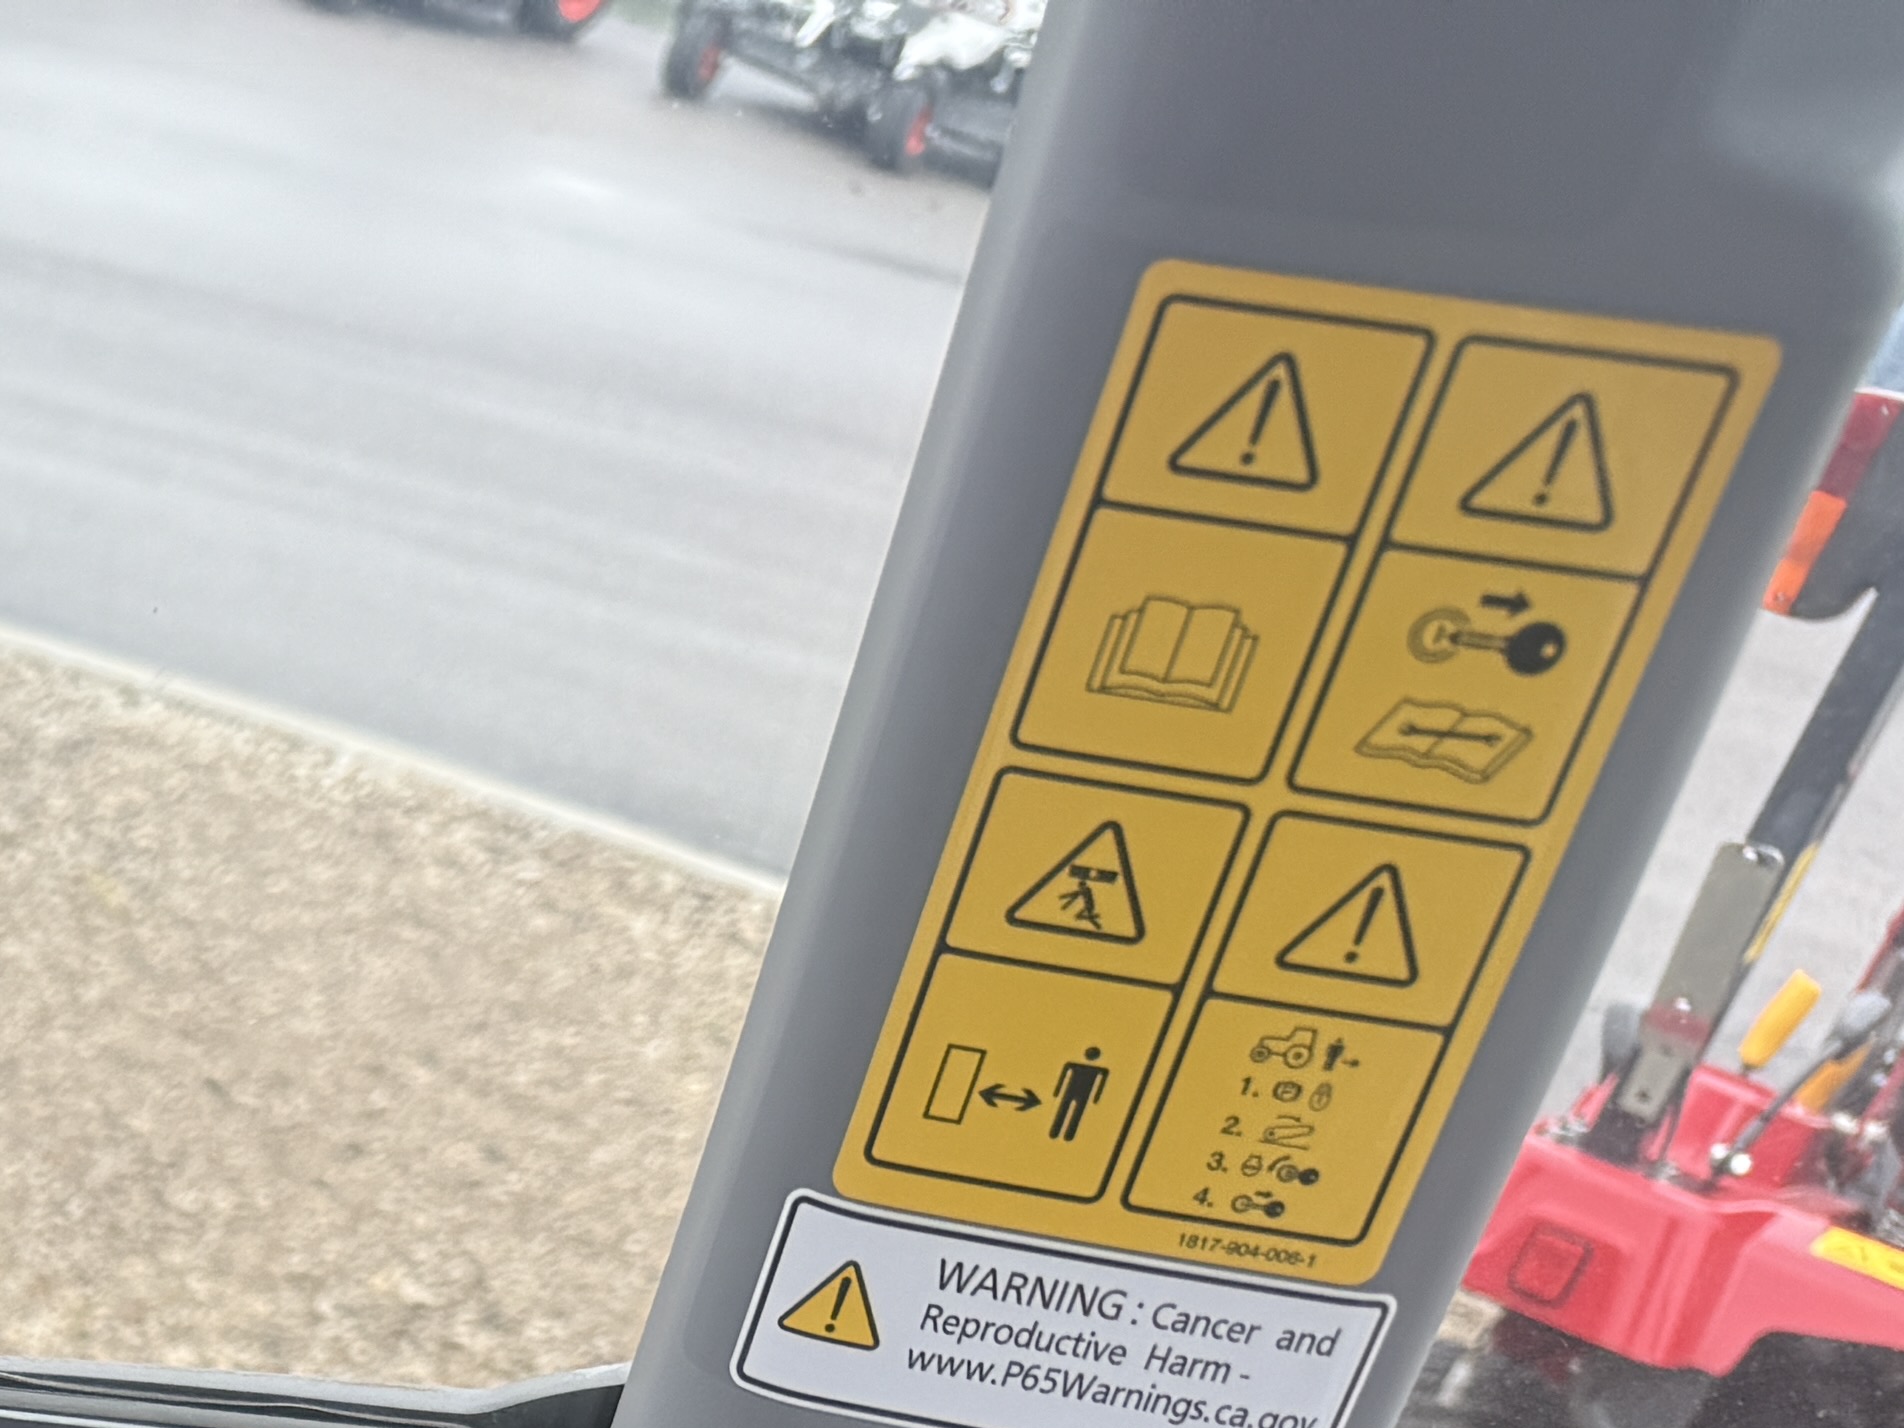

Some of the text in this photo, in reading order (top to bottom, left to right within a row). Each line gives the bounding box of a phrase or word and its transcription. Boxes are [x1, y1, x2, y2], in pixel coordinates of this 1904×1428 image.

[1241, 1076, 1259, 1099] 1.
[1221, 1115, 1242, 1137] 2.
[1206, 1151, 1228, 1173] 3.
[1192, 1187, 1213, 1209] 4.
[1151, 1302, 1262, 1347] Cancer
[1274, 1321, 1343, 1359] and
[919, 1302, 1128, 1368] Reproductive
[1143, 1343, 1232, 1386] Harm
